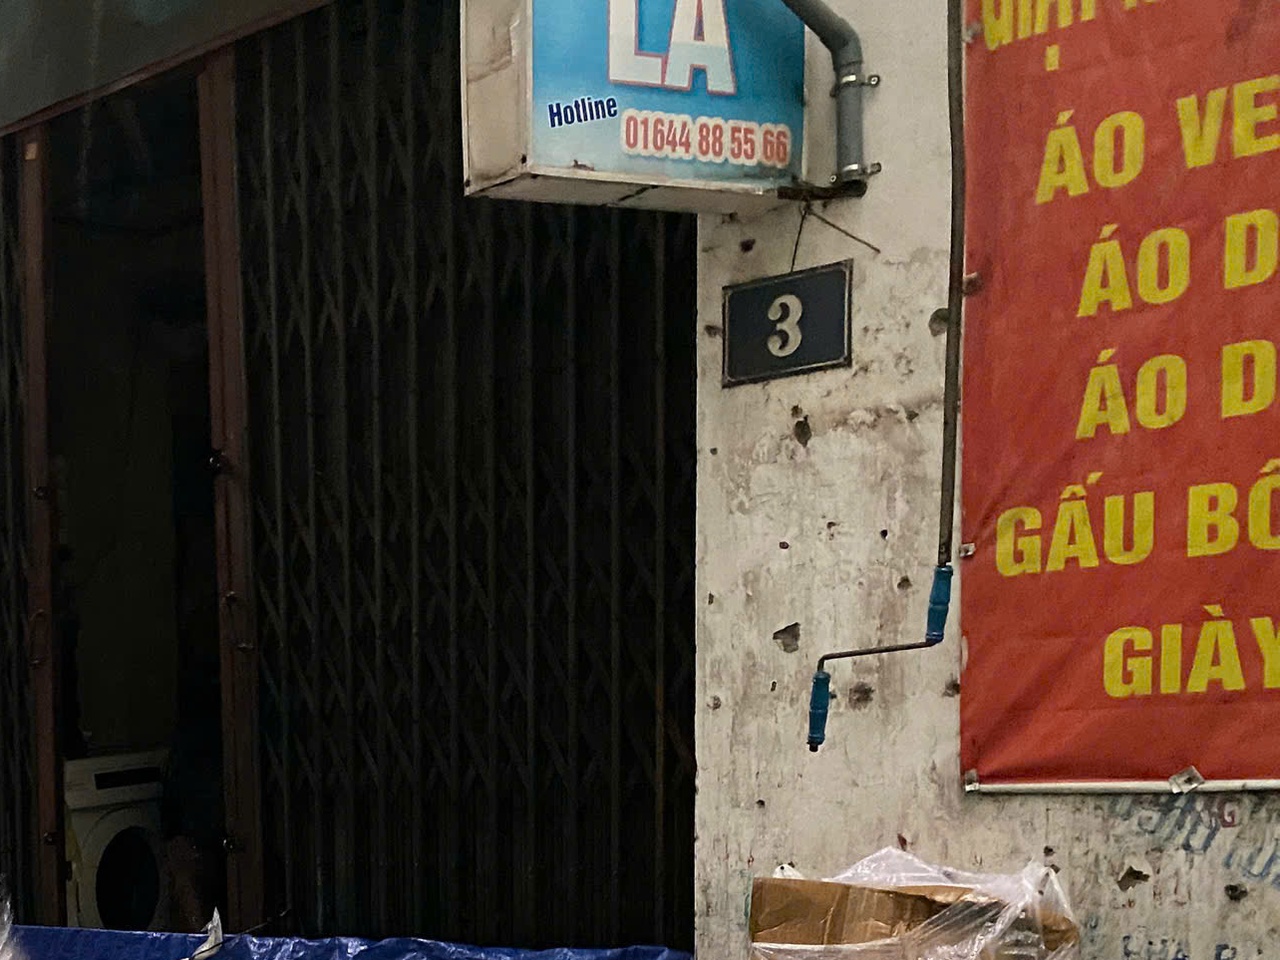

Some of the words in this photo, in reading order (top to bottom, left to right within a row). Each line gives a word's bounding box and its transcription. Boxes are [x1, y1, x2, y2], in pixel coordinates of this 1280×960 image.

[548, 95, 618, 128] Hotline
[624, 114, 691, 156] 01644
[697, 121, 723, 157] 88
[729, 126, 755, 161] 55
[762, 129, 789, 165] 66
[1035, 109, 1145, 205] ÁO
[1077, 223, 1190, 317] ÁO
[1225, 208, 1278, 290] D
[766, 294, 804, 358] 3
[1075, 348, 1188, 440] ÁO
[1222, 339, 1277, 418] D
[996, 471, 1155, 577] GẤU
[1104, 604, 1280, 698] GIÀY
